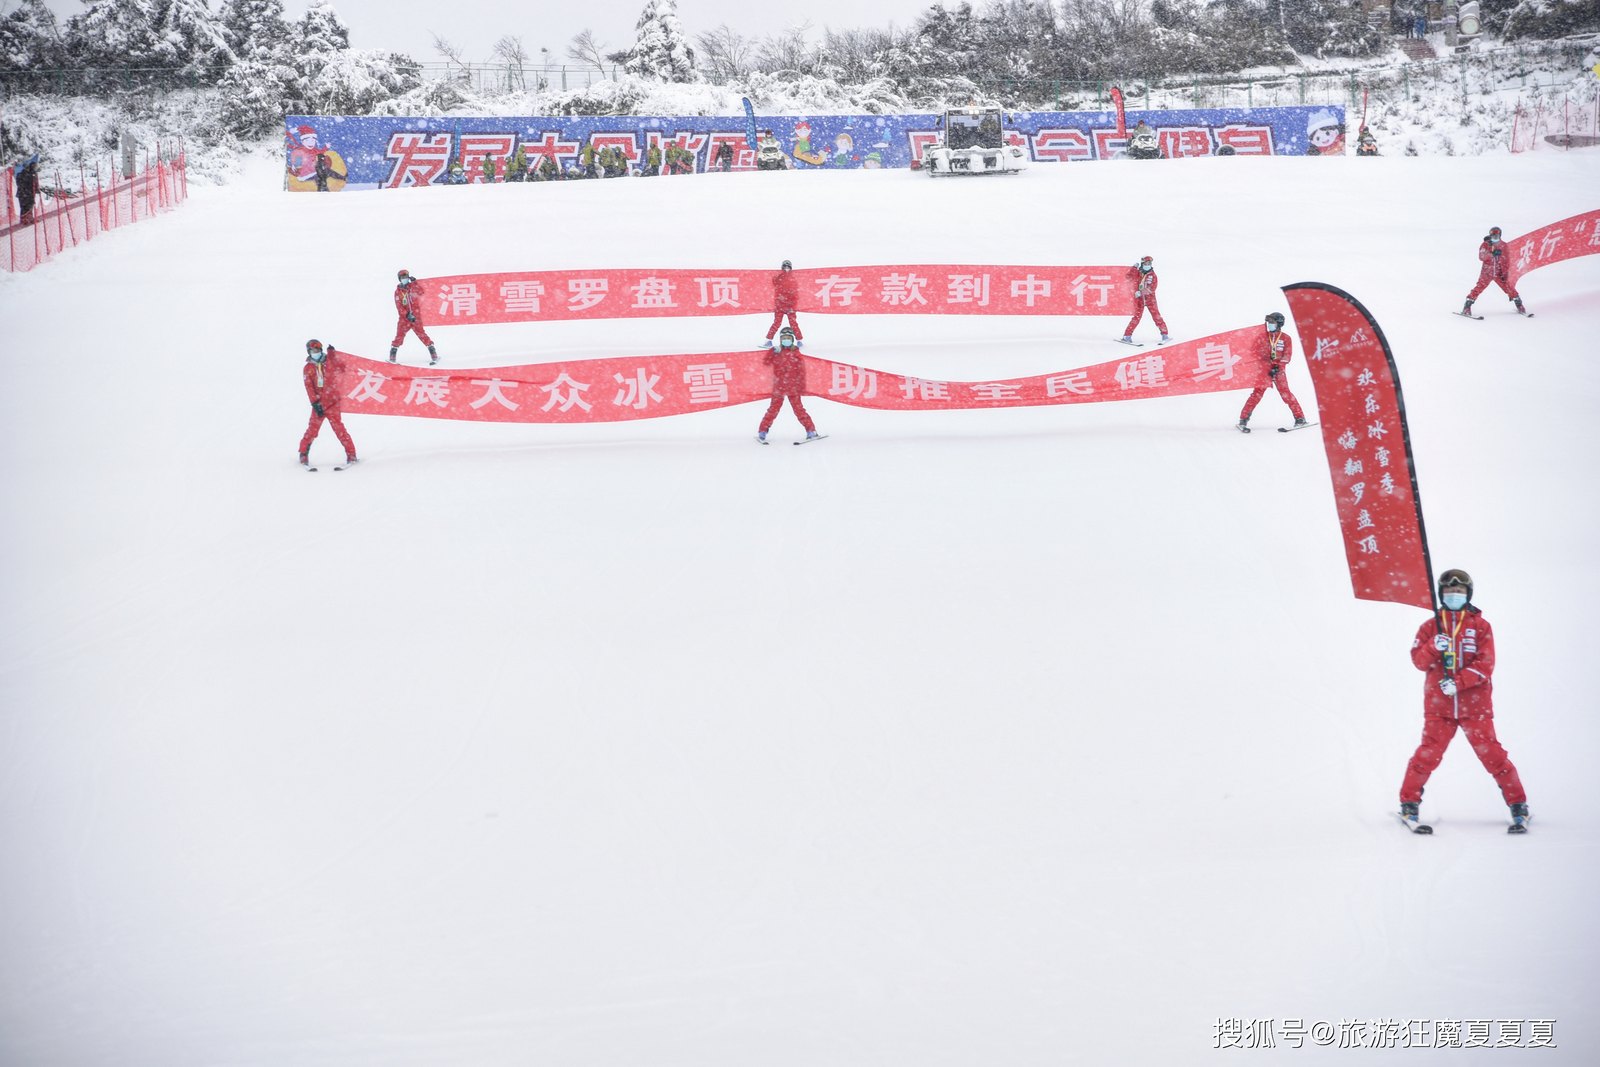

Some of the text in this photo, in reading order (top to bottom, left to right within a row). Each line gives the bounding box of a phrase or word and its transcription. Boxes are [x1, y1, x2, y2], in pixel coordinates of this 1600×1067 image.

[438, 273, 1113, 316] 滑雪罗盘顶 存款到中行
[347, 344, 1241, 412] 发展大众冰雪 助推全民健身
[1357, 368, 1396, 496] 欢乐冰雪季
[1338, 430, 1380, 555] 嗨翻罗盘顶
